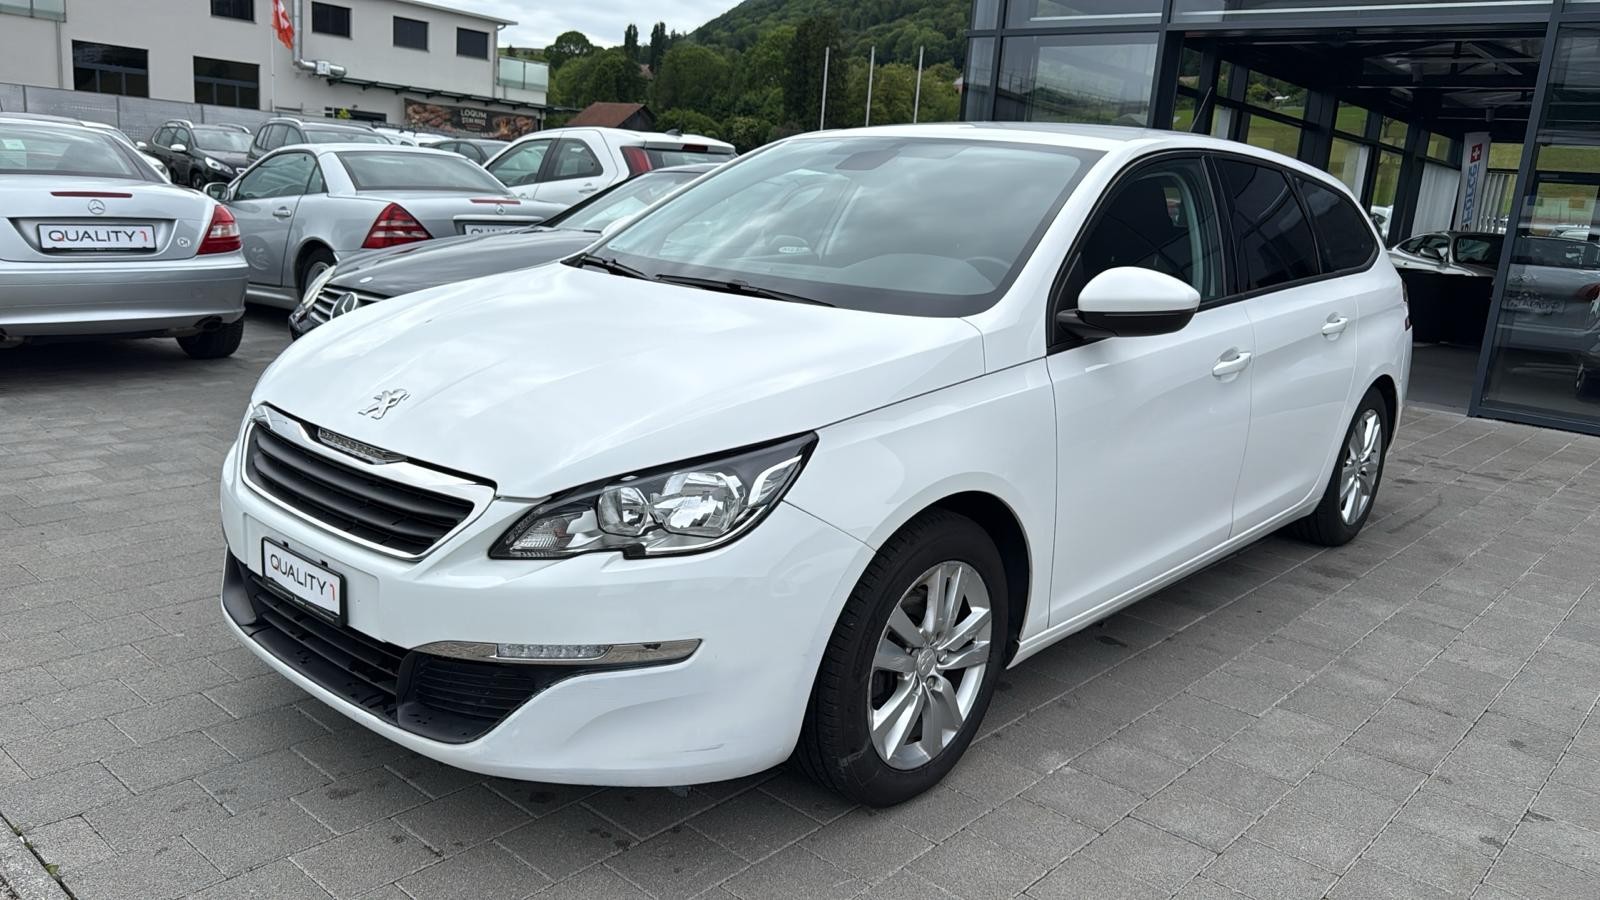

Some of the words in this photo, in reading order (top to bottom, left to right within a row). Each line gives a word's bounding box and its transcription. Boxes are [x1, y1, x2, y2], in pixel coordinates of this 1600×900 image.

[48, 230, 136, 242] QUALITY
[139, 230, 148, 242] 1
[270, 553, 327, 596] QUALITY
[329, 583, 336, 601] 1
